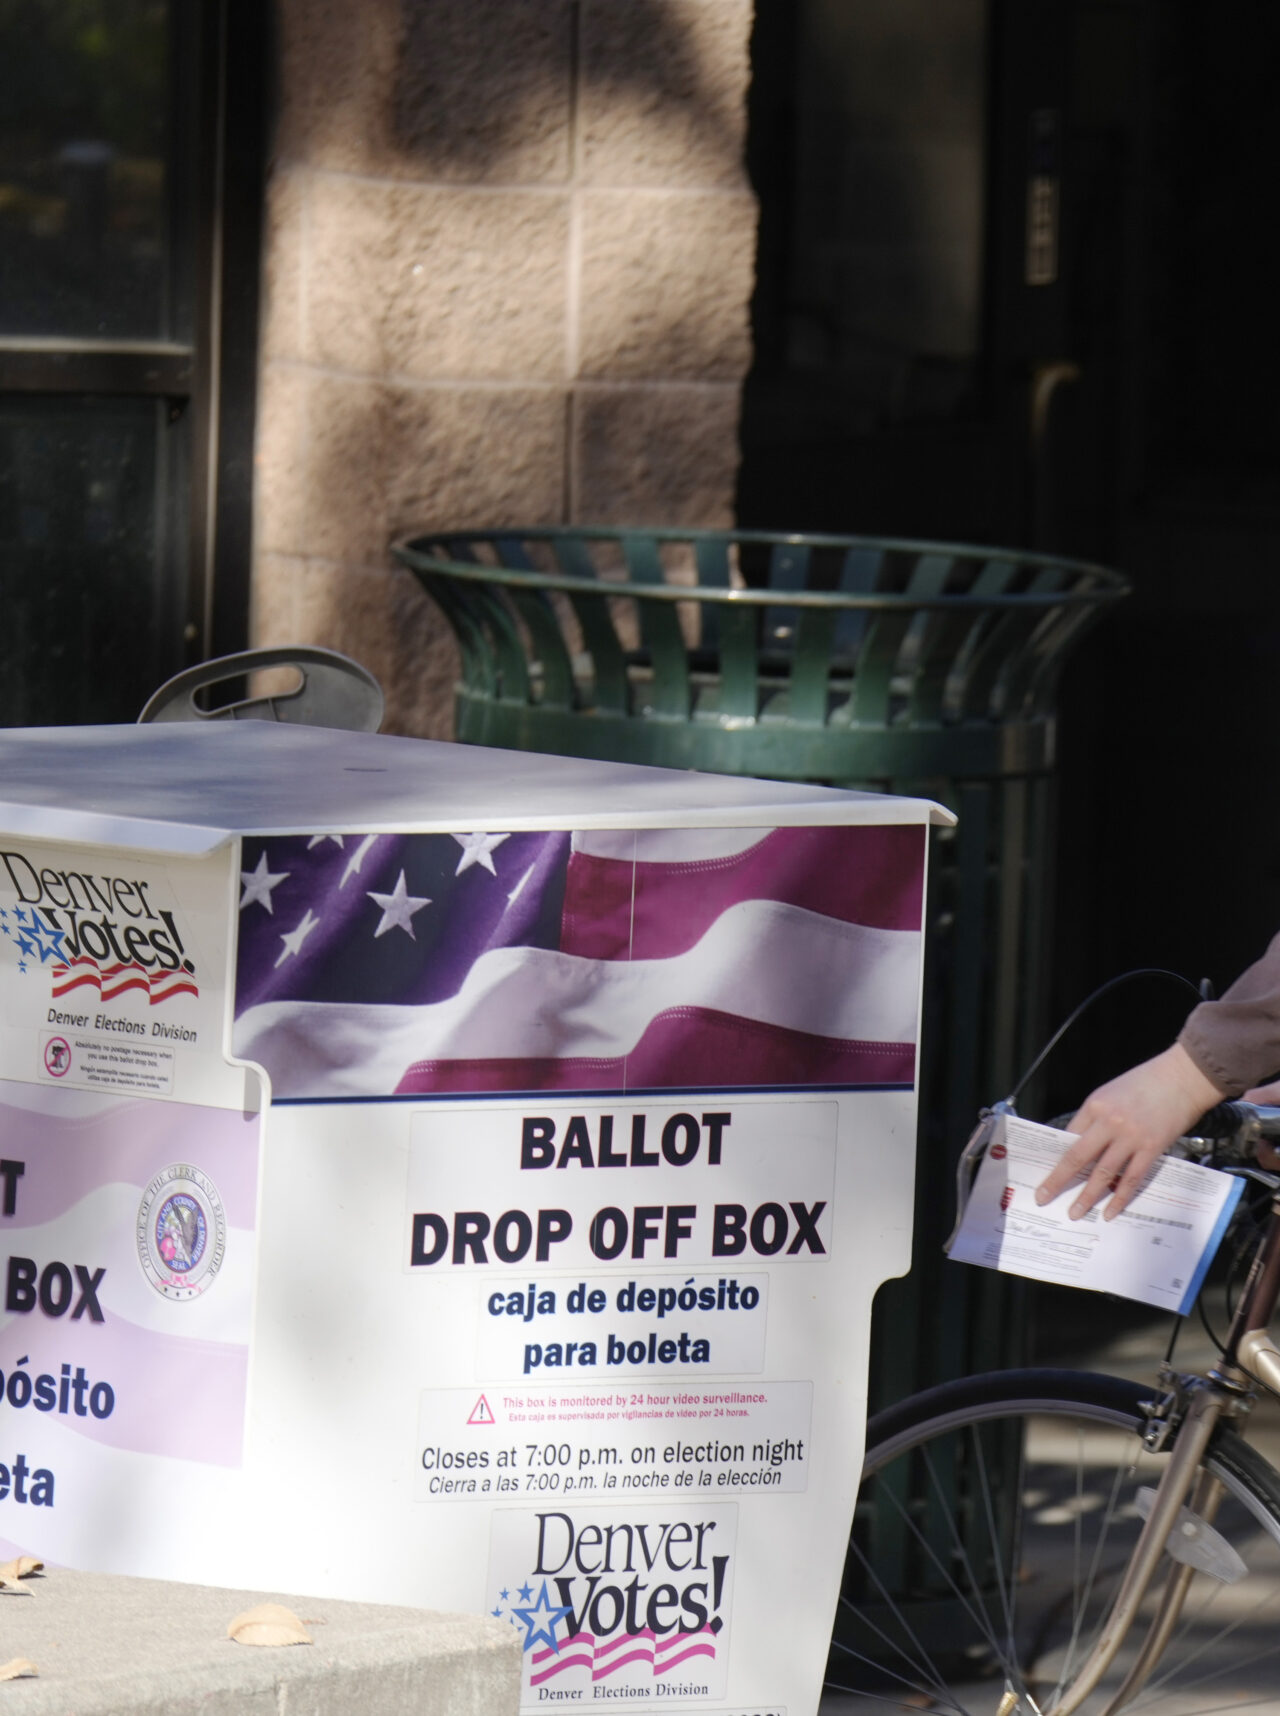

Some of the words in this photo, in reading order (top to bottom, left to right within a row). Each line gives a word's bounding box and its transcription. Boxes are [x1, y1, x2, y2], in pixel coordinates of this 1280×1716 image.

[0, 852, 159, 919] Denver
[39, 907, 195, 974] Votes!
[47, 1008, 89, 1028] Denver
[95, 1014, 146, 1035] Elections
[152, 1022, 197, 1042] Division
[520, 1112, 732, 1170] BALLOT
[168, 1167, 197, 1180] CLERK
[410, 1209, 573, 1266] DROP
[589, 1205, 697, 1261] OFF
[712, 1201, 828, 1257] BOX
[5, 1256, 107, 1324] BOX
[487, 1283, 556, 1322] caja
[566, 1283, 607, 1315] de
[616, 1277, 760, 1318] depósito
[523, 1339, 597, 1374] para
[606, 1333, 711, 1366] boleta
[0, 1355, 115, 1420] ósito
[503, 1397, 524, 1408] This
[527, 1397, 545, 1407] box
[549, 1396, 557, 1407] is
[560, 1395, 613, 1407] monitored
[616, 1395, 627, 1407] by
[630, 1394, 644, 1405] 24
[647, 1394, 670, 1405] hour
[673, 1393, 700, 1405] video
[703, 1392, 768, 1404] surveillance.
[509, 1412, 526, 1422] Esta
[528, 1412, 545, 1423] caja
[547, 1413, 557, 1421] es
[558, 1411, 606, 1422] supervisada
[607, 1411, 620, 1420] por
[665, 1410, 674, 1418] de
[699, 1409, 712, 1419] por
[714, 1408, 724, 1417] 24
[422, 1447, 490, 1470] Closes
[496, 1446, 518, 1467] at
[525, 1443, 571, 1467] 7:00
[579, 1447, 623, 1470] p.m.
[631, 1446, 655, 1464] on
[663, 1440, 745, 1464] election
[752, 1439, 804, 1466] night
[429, 1476, 477, 1494] Cierra
[481, 1479, 491, 1492] a
[496, 1475, 520, 1492] las
[525, 1473, 560, 1491] 7:00
[563, 1475, 597, 1493] p.m.
[603, 1472, 617, 1489] la
[622, 1471, 670, 1488] noche
[674, 1470, 694, 1487] de
[698, 1470, 712, 1486] la
[717, 1467, 782, 1486] elección
[532, 1512, 717, 1576] Denver
[553, 1555, 730, 1640] Votes!
[538, 1688, 583, 1701] Denver
[592, 1685, 650, 1698] Elections
[655, 1683, 708, 1697] Division
